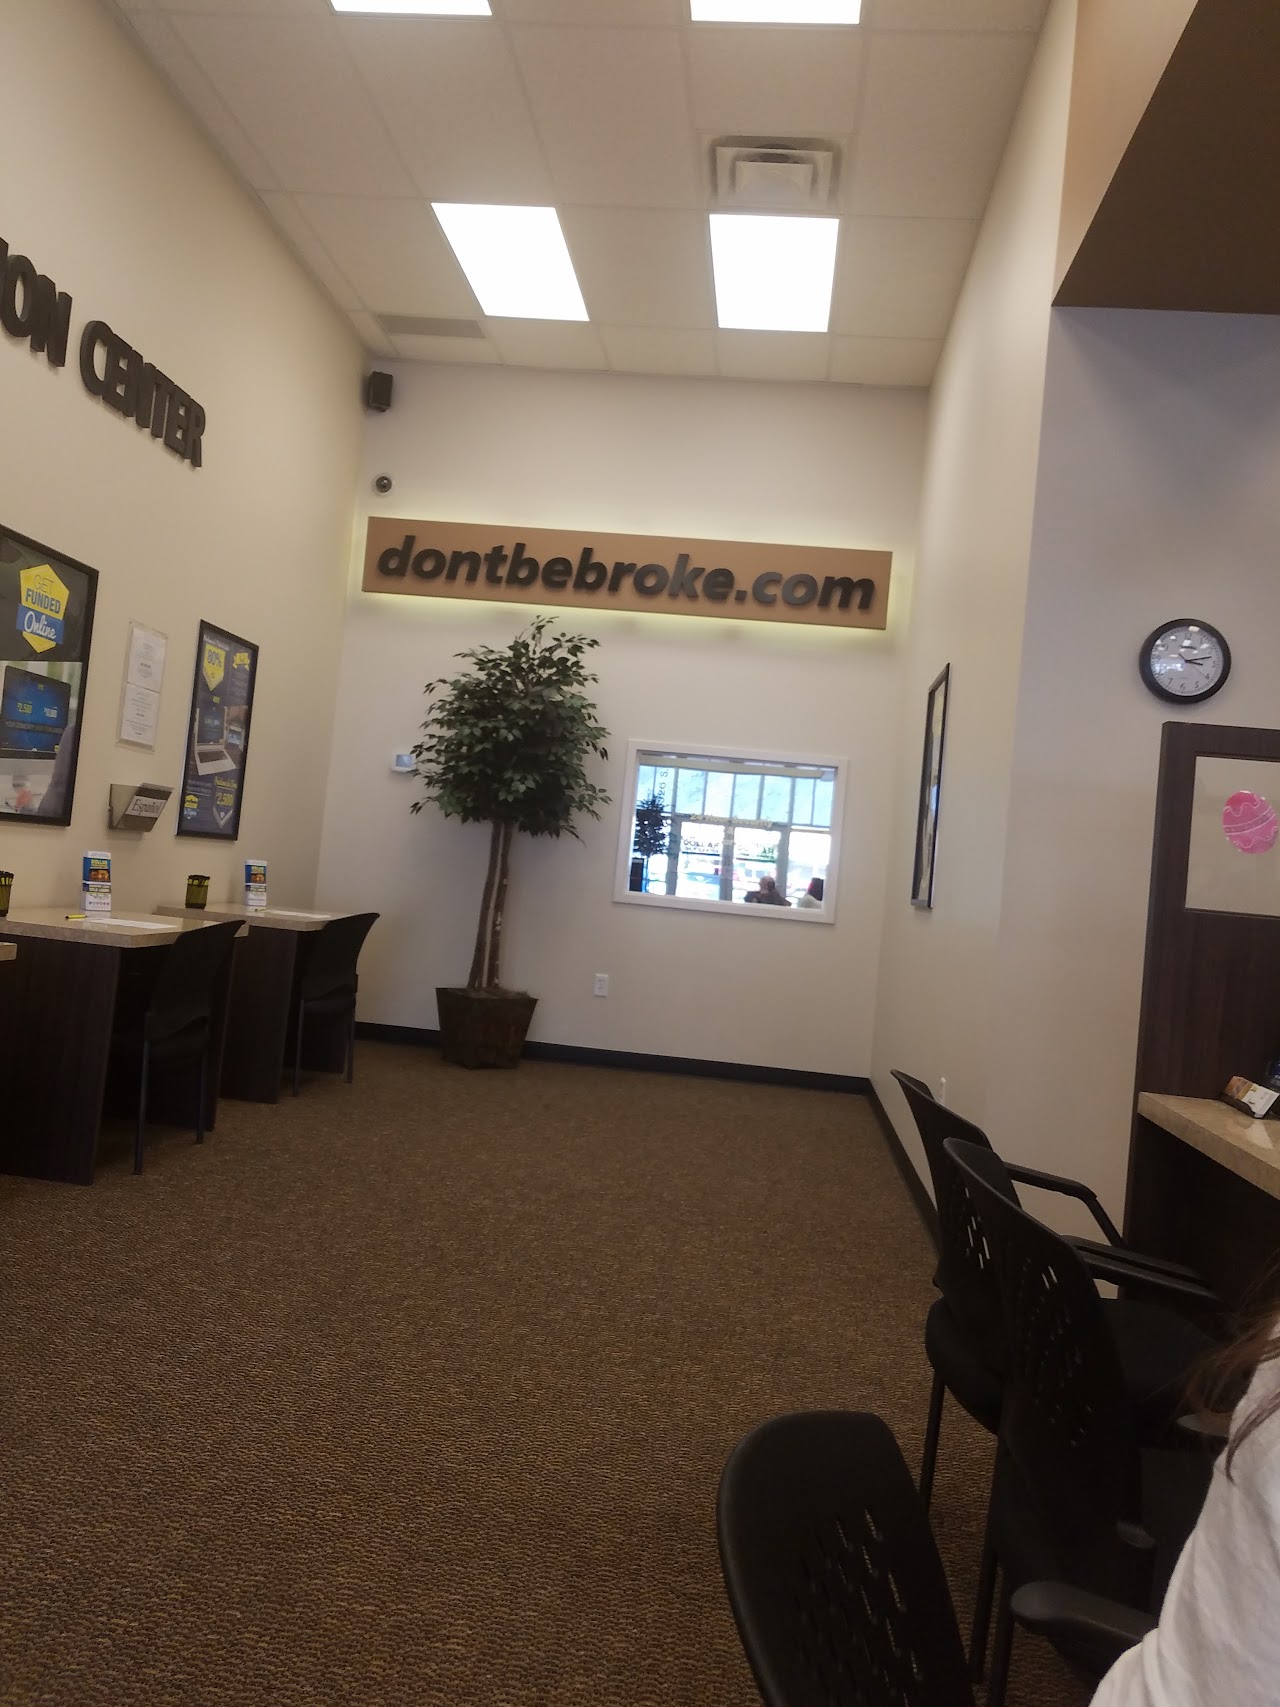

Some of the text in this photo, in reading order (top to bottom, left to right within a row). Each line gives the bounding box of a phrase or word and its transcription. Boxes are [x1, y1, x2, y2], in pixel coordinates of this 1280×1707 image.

[79, 320, 206, 468] CENTER
[34, 574, 55, 595] GET
[376, 534, 877, 612] dontbebroke.com
[25, 587, 62, 614] FUNDED
[24, 610, 57, 640] Online
